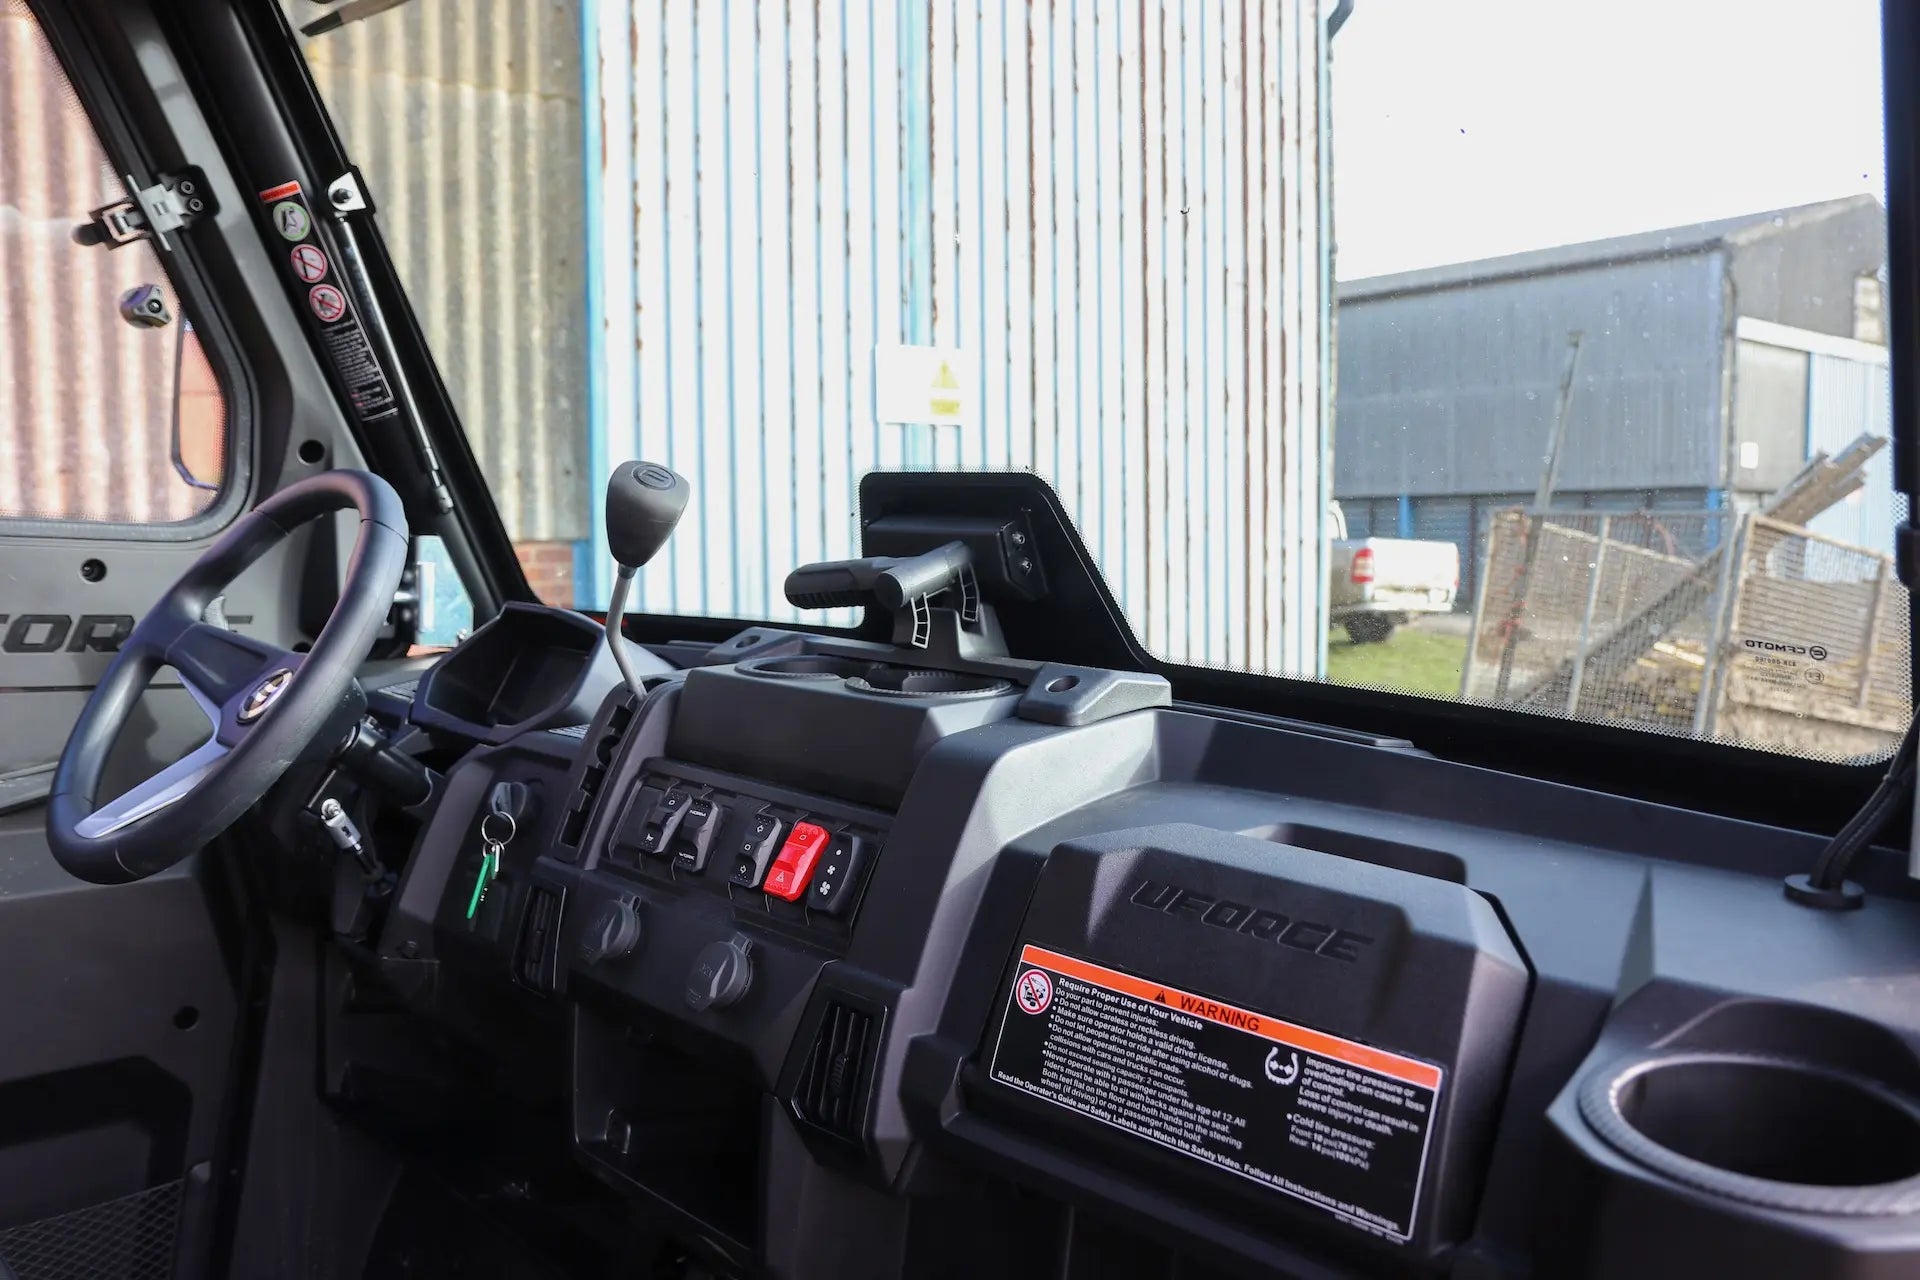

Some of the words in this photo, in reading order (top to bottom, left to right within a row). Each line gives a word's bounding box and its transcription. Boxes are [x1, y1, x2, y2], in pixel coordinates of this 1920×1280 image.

[1130, 880, 1375, 963] UFORCE
[1058, 978, 1090, 995] Require
[1090, 988, 1119, 1004] Proper
[1120, 997, 1137, 1008] Use
[1138, 1002, 1147, 1011] of
[1148, 1006, 1169, 1018] Your
[1169, 1012, 1203, 1029] Vehicle
[1065, 992, 1080, 1001] your
[1081, 996, 1094, 1006] part
[1103, 1003, 1129, 1017] prevent
[1130, 1012, 1158, 1026] injuries:
[1081, 1005, 1099, 1016] allow
[1099, 1011, 1129, 1025] careless
[1138, 1024, 1168, 1038] reckless
[1168, 1034, 1196, 1049] driving.
[1181, 995, 1260, 1031] WARNING
[1050, 1033, 1081, 1048] collisions
[1081, 1044, 1096, 1053] with
[1096, 1050, 1111, 1059] cars
[1112, 1055, 1126, 1064] and
[1126, 1060, 1148, 1072] trucks
[1149, 1069, 1162, 1077] can
[1051, 1024, 1062, 1032] Do
[1062, 1028, 1073, 1036] not
[1074, 1032, 1092, 1043] allow
[1092, 1038, 1125, 1056] operation
[1135, 1053, 1157, 1067] public
[1054, 1015, 1064, 1023] Do
[1065, 1018, 1076, 1027] not
[1076, 1022, 1085, 1030] let
[1085, 1026, 1109, 1040] people
[1109, 1034, 1127, 1045] drive
[1137, 1043, 1151, 1053] ride
[1152, 1048, 1169, 1059] after
[1169, 1054, 1190, 1068] using
[1191, 1061, 1218, 1076] alcohol
[1057, 1006, 1076, 1018] Make
[1077, 1014, 1093, 1023] sure
[1093, 1019, 1125, 1036] operator
[1126, 1029, 1147, 1041] holds
[1154, 1039, 1173, 1050] valid
[1174, 1045, 1197, 1058] driver
[1046, 1050, 1066, 1062] Never
[1067, 1058, 1095, 1074] operate
[1095, 1068, 1110, 1078] with
[1117, 1077, 1156, 1097] passenger
[1157, 1090, 1180, 1104] under
[1181, 1099, 1194, 1109] the
[1195, 1105, 1210, 1116] age
[1211, 1110, 1220, 1118] of
[1057, 1045, 1068, 1054] not
[1068, 1049, 1091, 1062] exceed
[1091, 1058, 1115, 1072] seating
[1040, 1076, 1061, 1089] wheel
[1123, 1109, 1162, 1128] passenger
[1163, 1122, 1182, 1135] hand
[1042, 1068, 1058, 1079] Both
[1059, 1074, 1072, 1084] feet
[1073, 1079, 1085, 1089] flat
[1095, 1088, 1107, 1097] the
[1108, 1092, 1125, 1104] floor
[1126, 1099, 1140, 1109] and
[1141, 1104, 1158, 1116] both
[1159, 1111, 1182, 1125] hands
[1195, 1124, 1208, 1135] the
[1208, 1130, 1242, 1149] steering
[1044, 1059, 1064, 1071] riders
[1065, 1067, 1082, 1078] must
[1083, 1074, 1093, 1082] be
[1094, 1077, 1109, 1088] able
[1119, 1086, 1128, 1095] sit
[1129, 1090, 1144, 1101] with
[1145, 1096, 1167, 1109] backs
[1168, 1104, 1196, 1121] against
[1197, 1115, 1210, 1125] the
[997, 1071, 1013, 1081] Read
[1013, 1077, 1024, 1086] the
[1024, 1081, 1057, 1100] Operator's
[1057, 1094, 1076, 1106] Guide
[1077, 1101, 1089, 1111] and
[1089, 1106, 1111, 1120] Safety
[1112, 1115, 1137, 1129] Labels
[1138, 1124, 1152, 1135] and
[1152, 1130, 1176, 1144] Watch
[1177, 1139, 1190, 1150] the
[1190, 1145, 1216, 1161] Safety
[1244, 1164, 1271, 1180] Follow
[1272, 1174, 1284, 1185] All
[1284, 1179, 1336, 1205] Instructions
[1337, 1199, 1355, 1212] and
